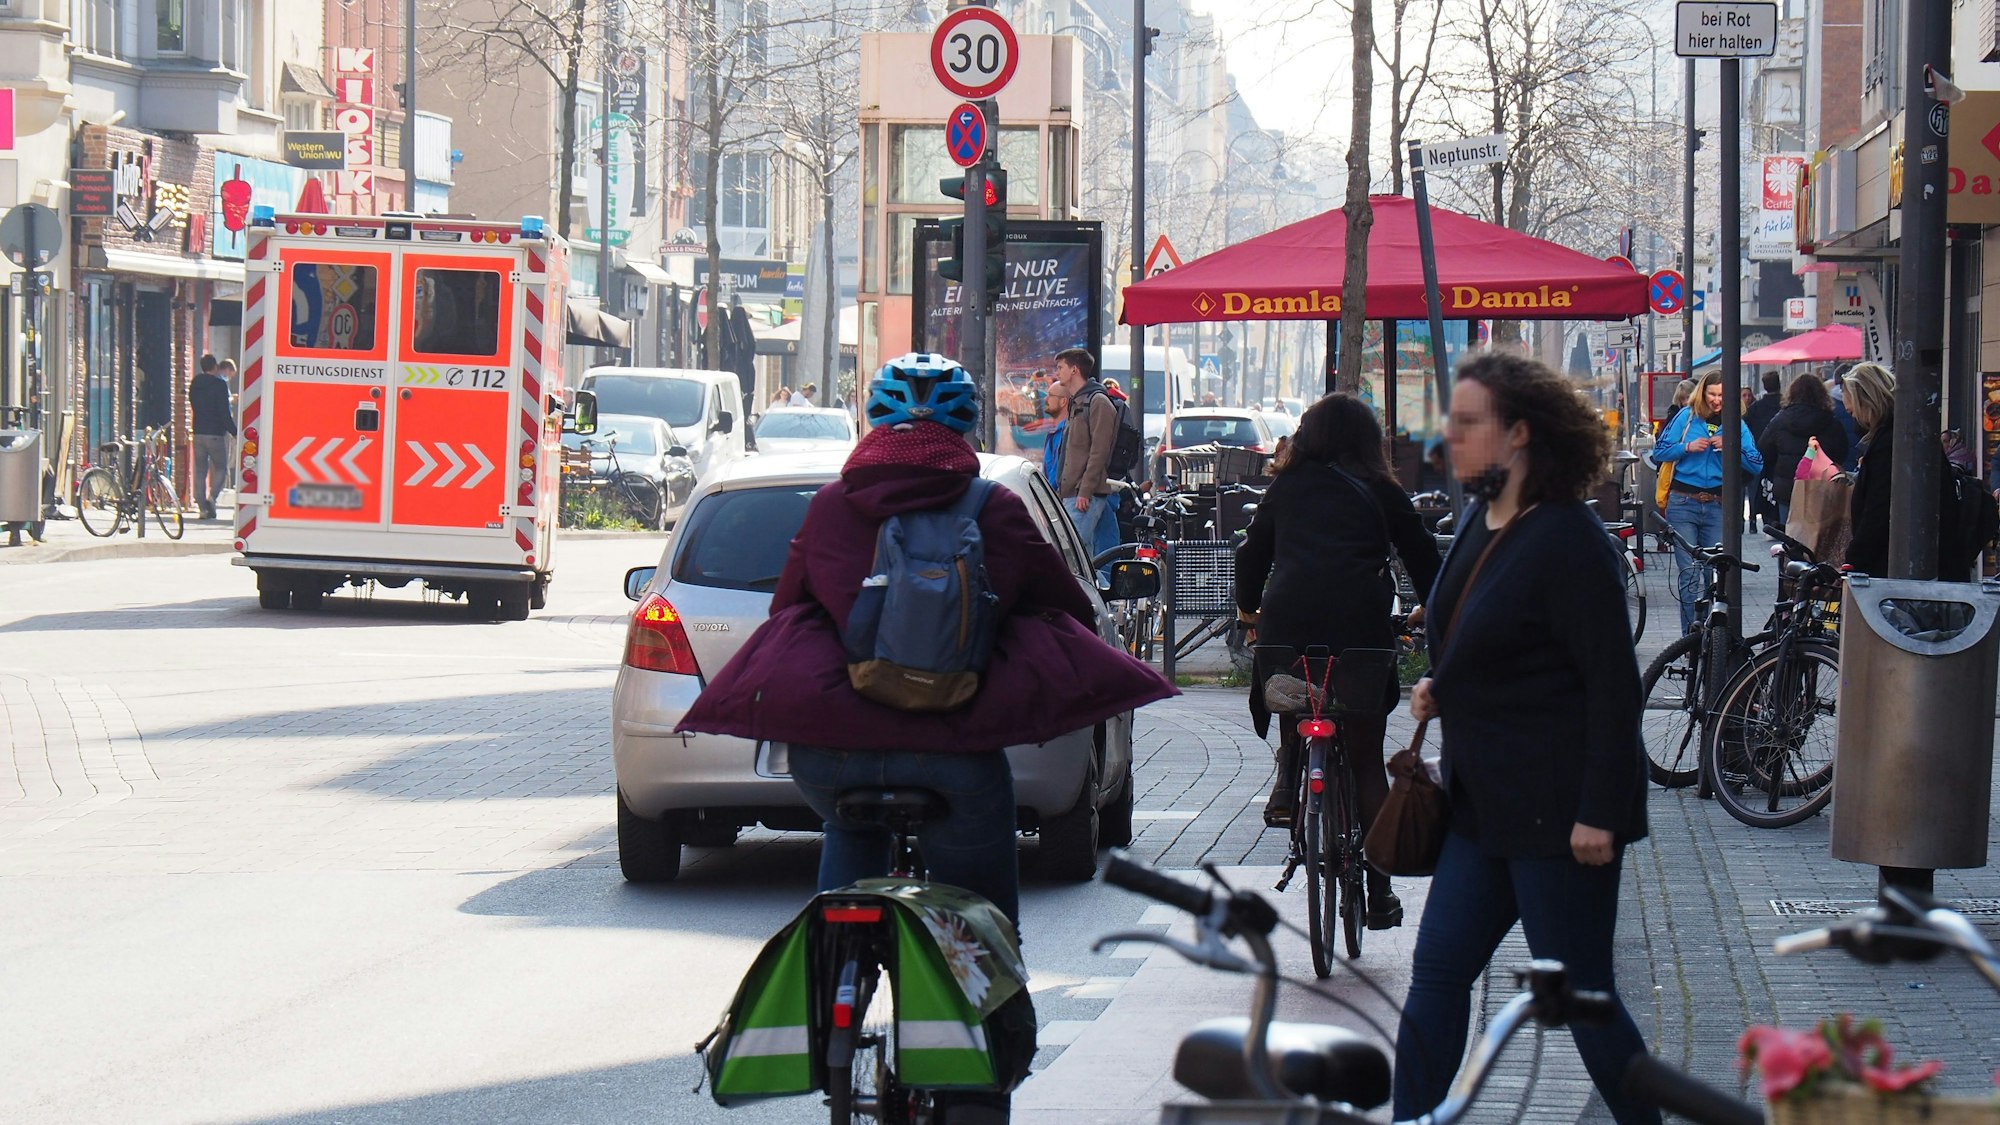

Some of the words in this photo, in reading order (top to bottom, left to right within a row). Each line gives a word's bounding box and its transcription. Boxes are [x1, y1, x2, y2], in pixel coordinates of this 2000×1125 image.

[1701, 11, 1722, 26] bei
[1726, 12, 1751, 27] Rot
[1688, 33, 1715, 48] hier
[1719, 34, 1762, 49] halten
[949, 33, 999, 74] 30
[336, 48, 373, 195] KIOSK
[287, 143, 324, 151] Western
[1428, 143, 1501, 167] Neptunstr.
[1013, 259, 1058, 279] NUR
[1024, 278, 1069, 298] LIVE
[1452, 285, 1572, 309] Damla
[930, 307, 952, 316] ALTE
[1011, 302, 1031, 310] NEU
[1033, 298, 1080, 309] ENTFACHT.
[1222, 289, 1342, 315] Damla
[277, 363, 385, 379] RETTUNGSDIENST
[471, 368, 506, 389] 112
[693, 623, 730, 632] TOYOTA
